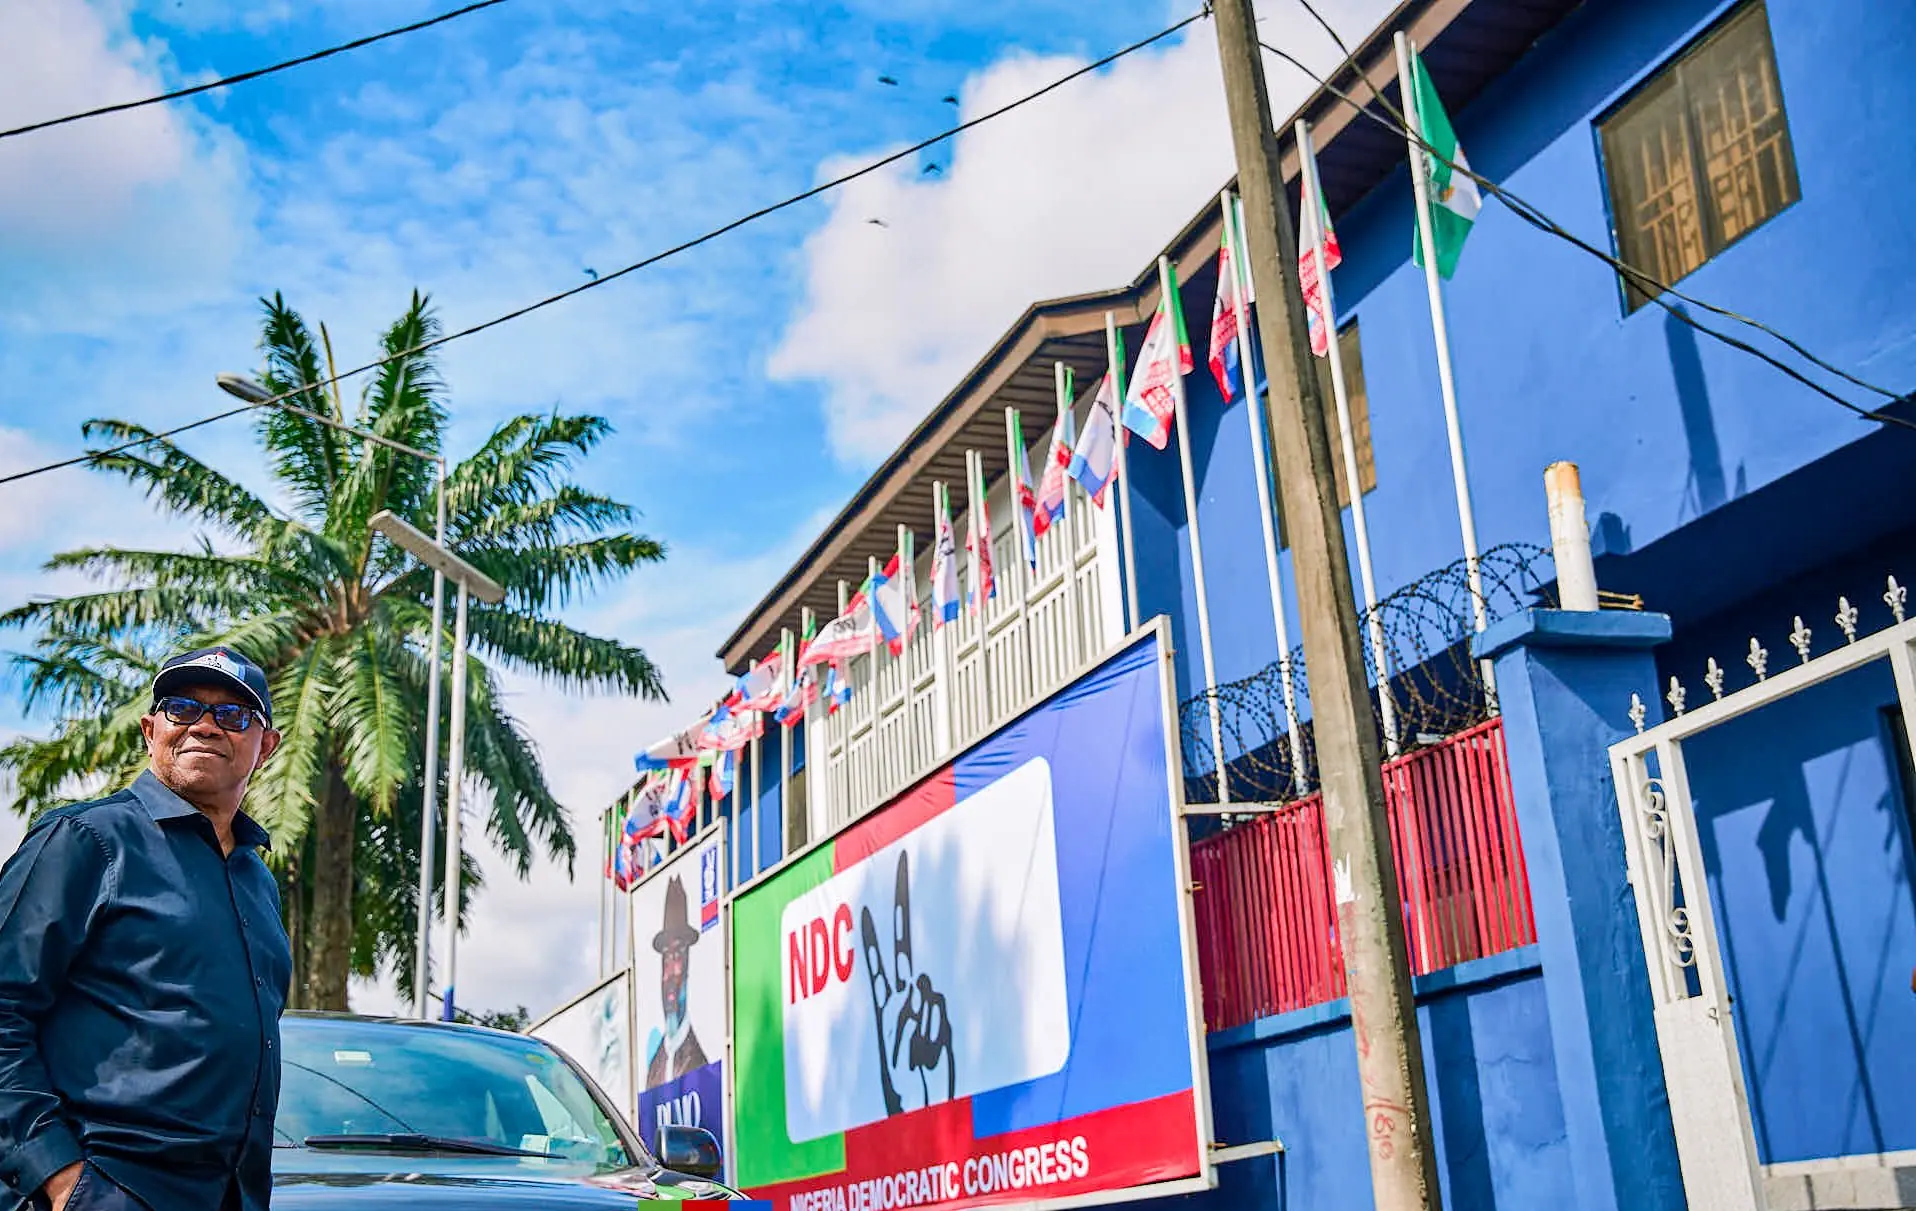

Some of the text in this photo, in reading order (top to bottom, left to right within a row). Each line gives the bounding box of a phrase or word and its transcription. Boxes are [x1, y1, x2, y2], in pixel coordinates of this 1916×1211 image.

[789, 903, 855, 1005] NDC
[790, 1135, 1089, 1211] NIGERIA DEMOCRATIC CONGRESS
